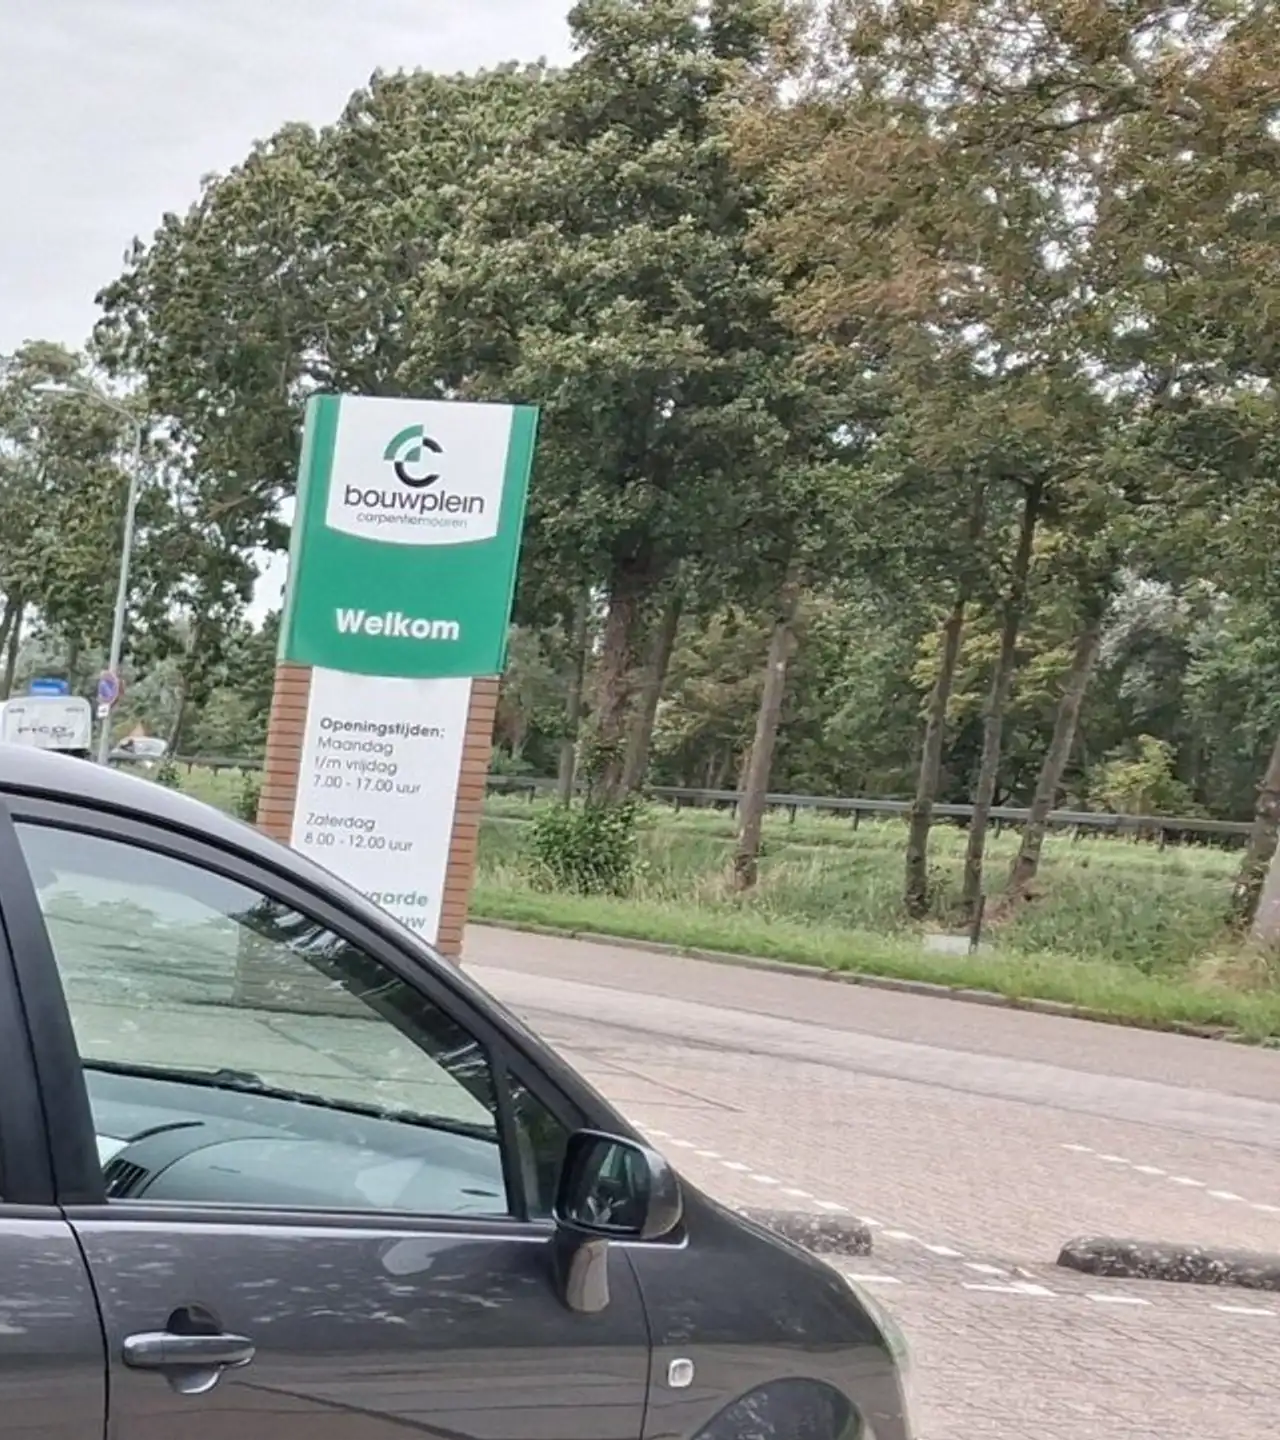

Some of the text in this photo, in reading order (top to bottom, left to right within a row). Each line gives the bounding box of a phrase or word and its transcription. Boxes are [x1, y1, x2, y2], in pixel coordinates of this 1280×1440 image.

[344, 484, 485, 514] bouwplein
[336, 608, 460, 640] Welkom
[320, 717, 445, 738] Openingstijden:
[318, 736, 393, 756] Maandag
[346, 758, 397, 776] vrijdag
[313, 774, 342, 788] 7.00
[357, 778, 393, 792] 17.00
[396, 784, 421, 794] uur
[306, 812, 376, 832] Zaterdag
[349, 834, 386, 849] 12.00
[389, 841, 413, 851] uur
[365, 891, 428, 907] aarde
